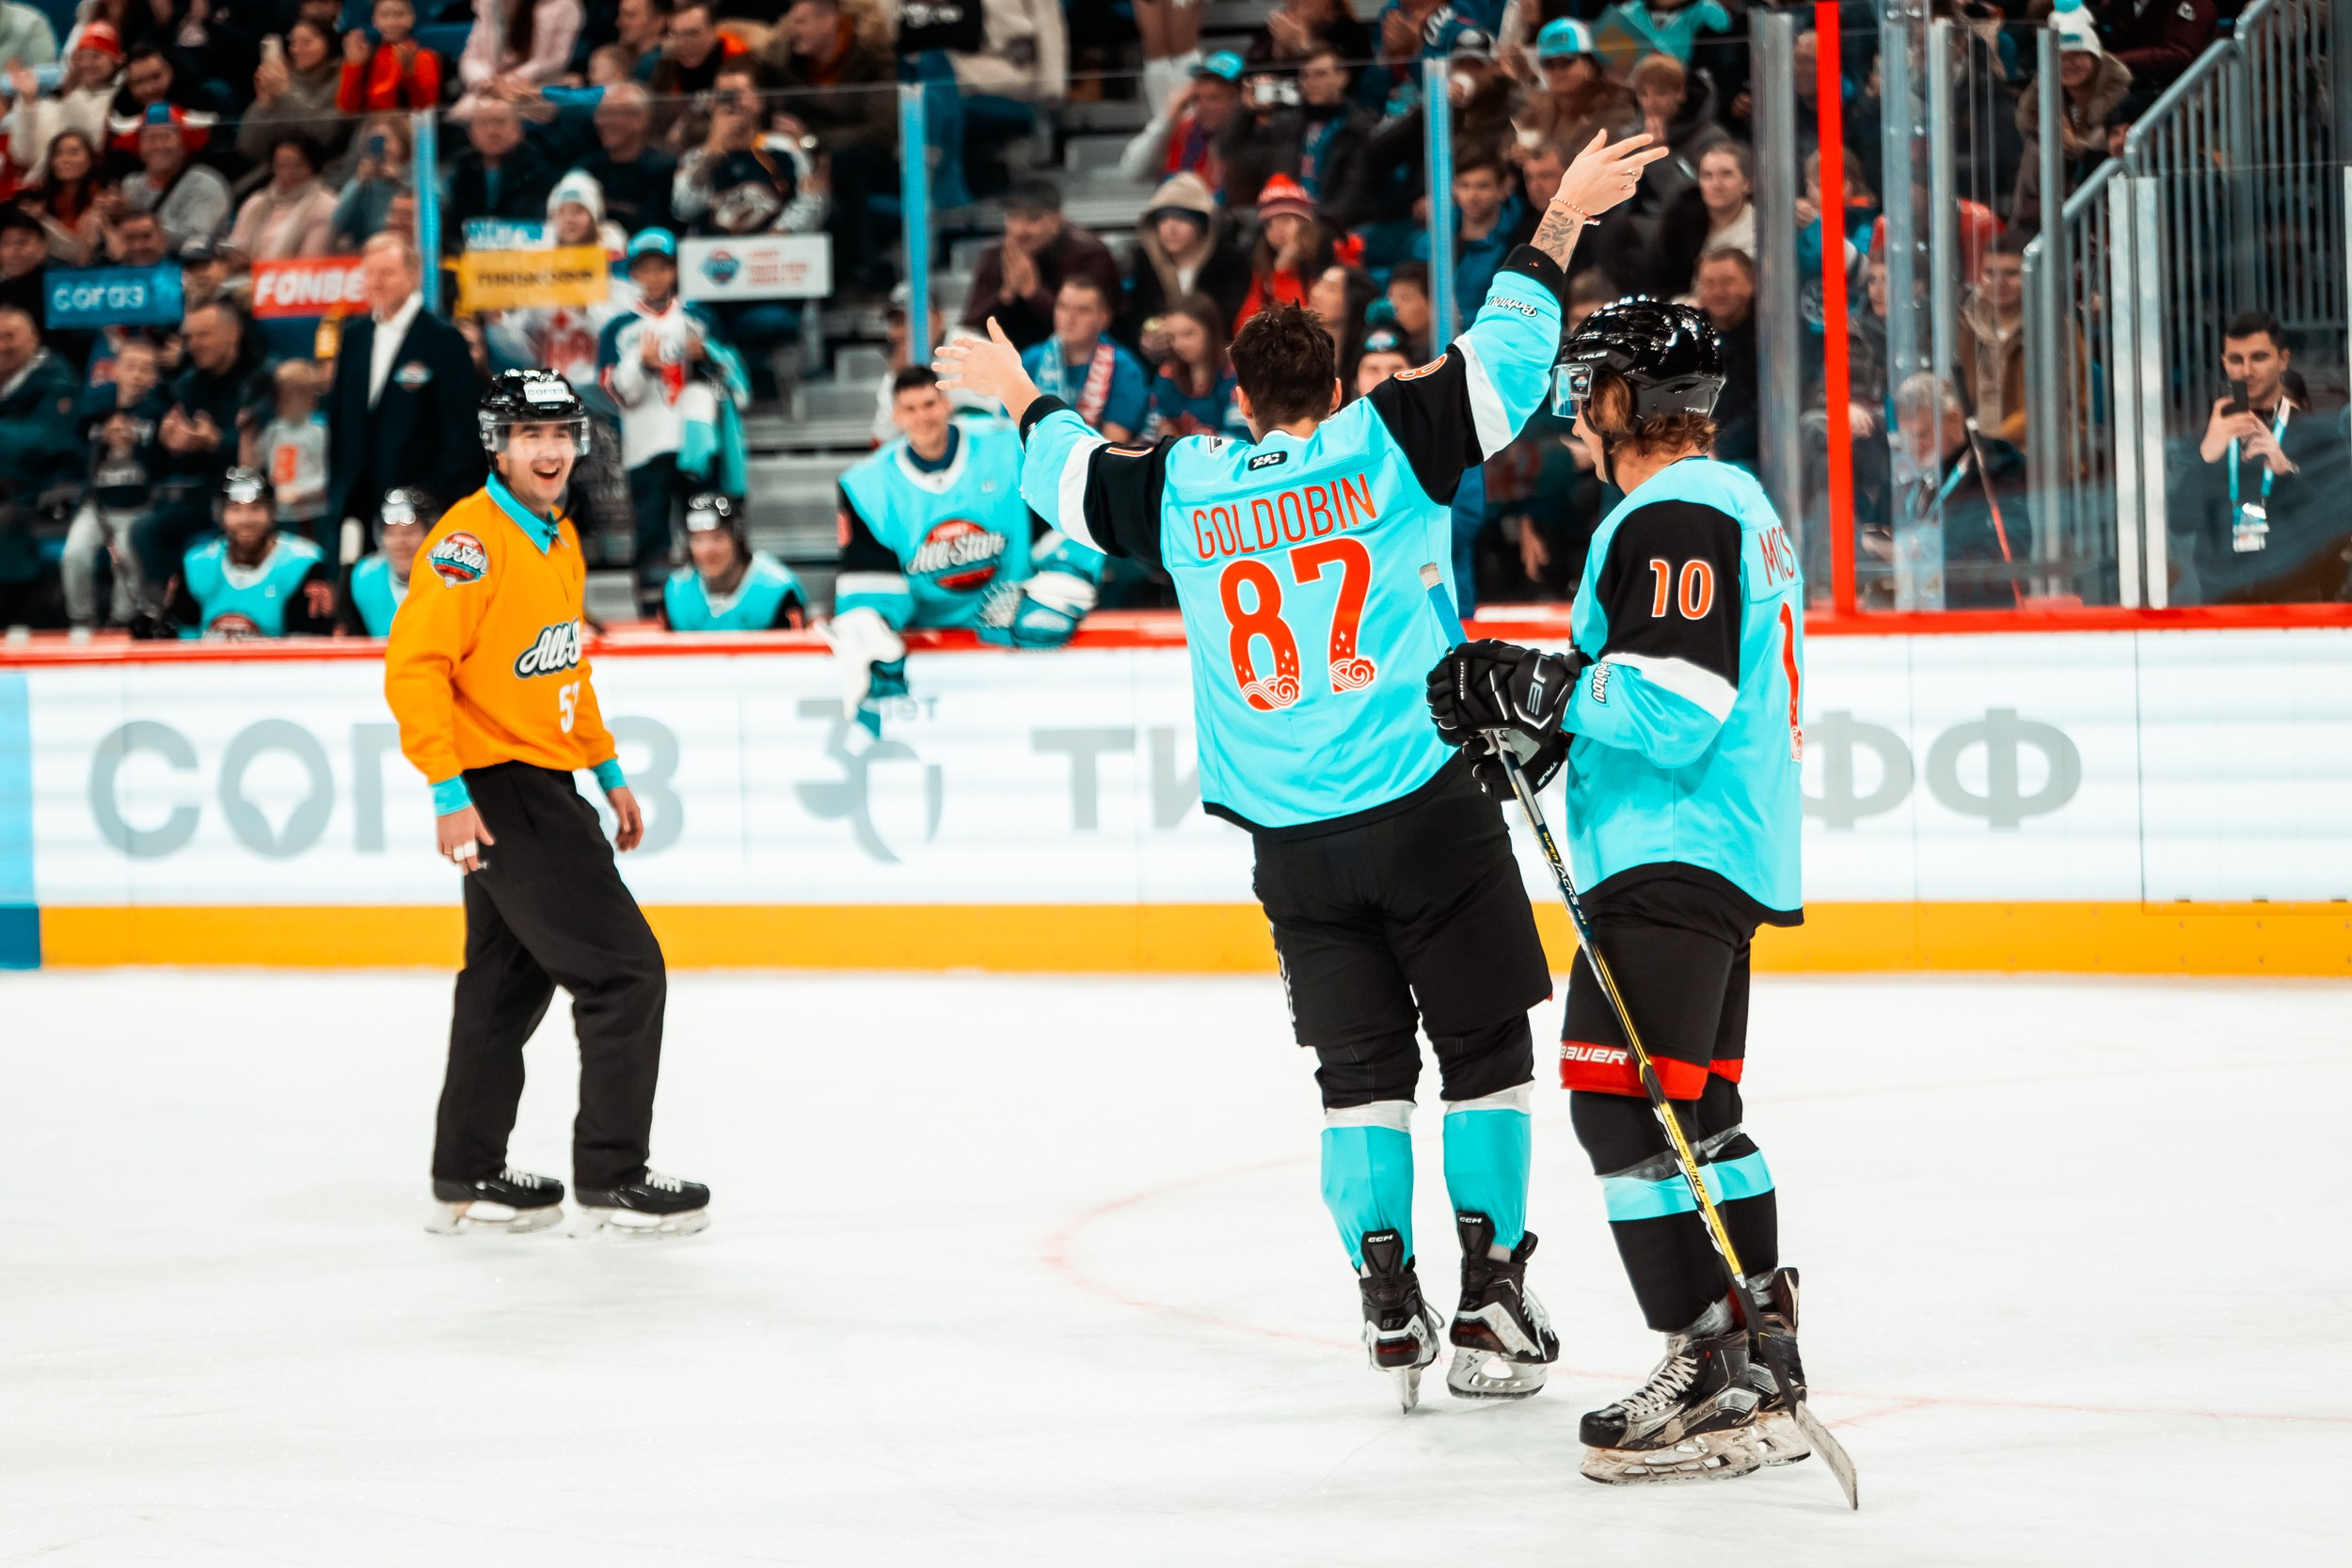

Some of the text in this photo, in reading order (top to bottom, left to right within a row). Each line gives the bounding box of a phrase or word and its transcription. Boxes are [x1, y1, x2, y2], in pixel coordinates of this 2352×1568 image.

[254, 270, 367, 306] FONBE
[1576, 351, 1608, 361] TRUE
[1193, 473, 1377, 560] GOLDOBIN
[1649, 559, 1714, 621] 10
[1218, 535, 1378, 712] 87
[1543, 831, 1559, 862] SUPER
[1368, 1234, 1393, 1243] CCM
